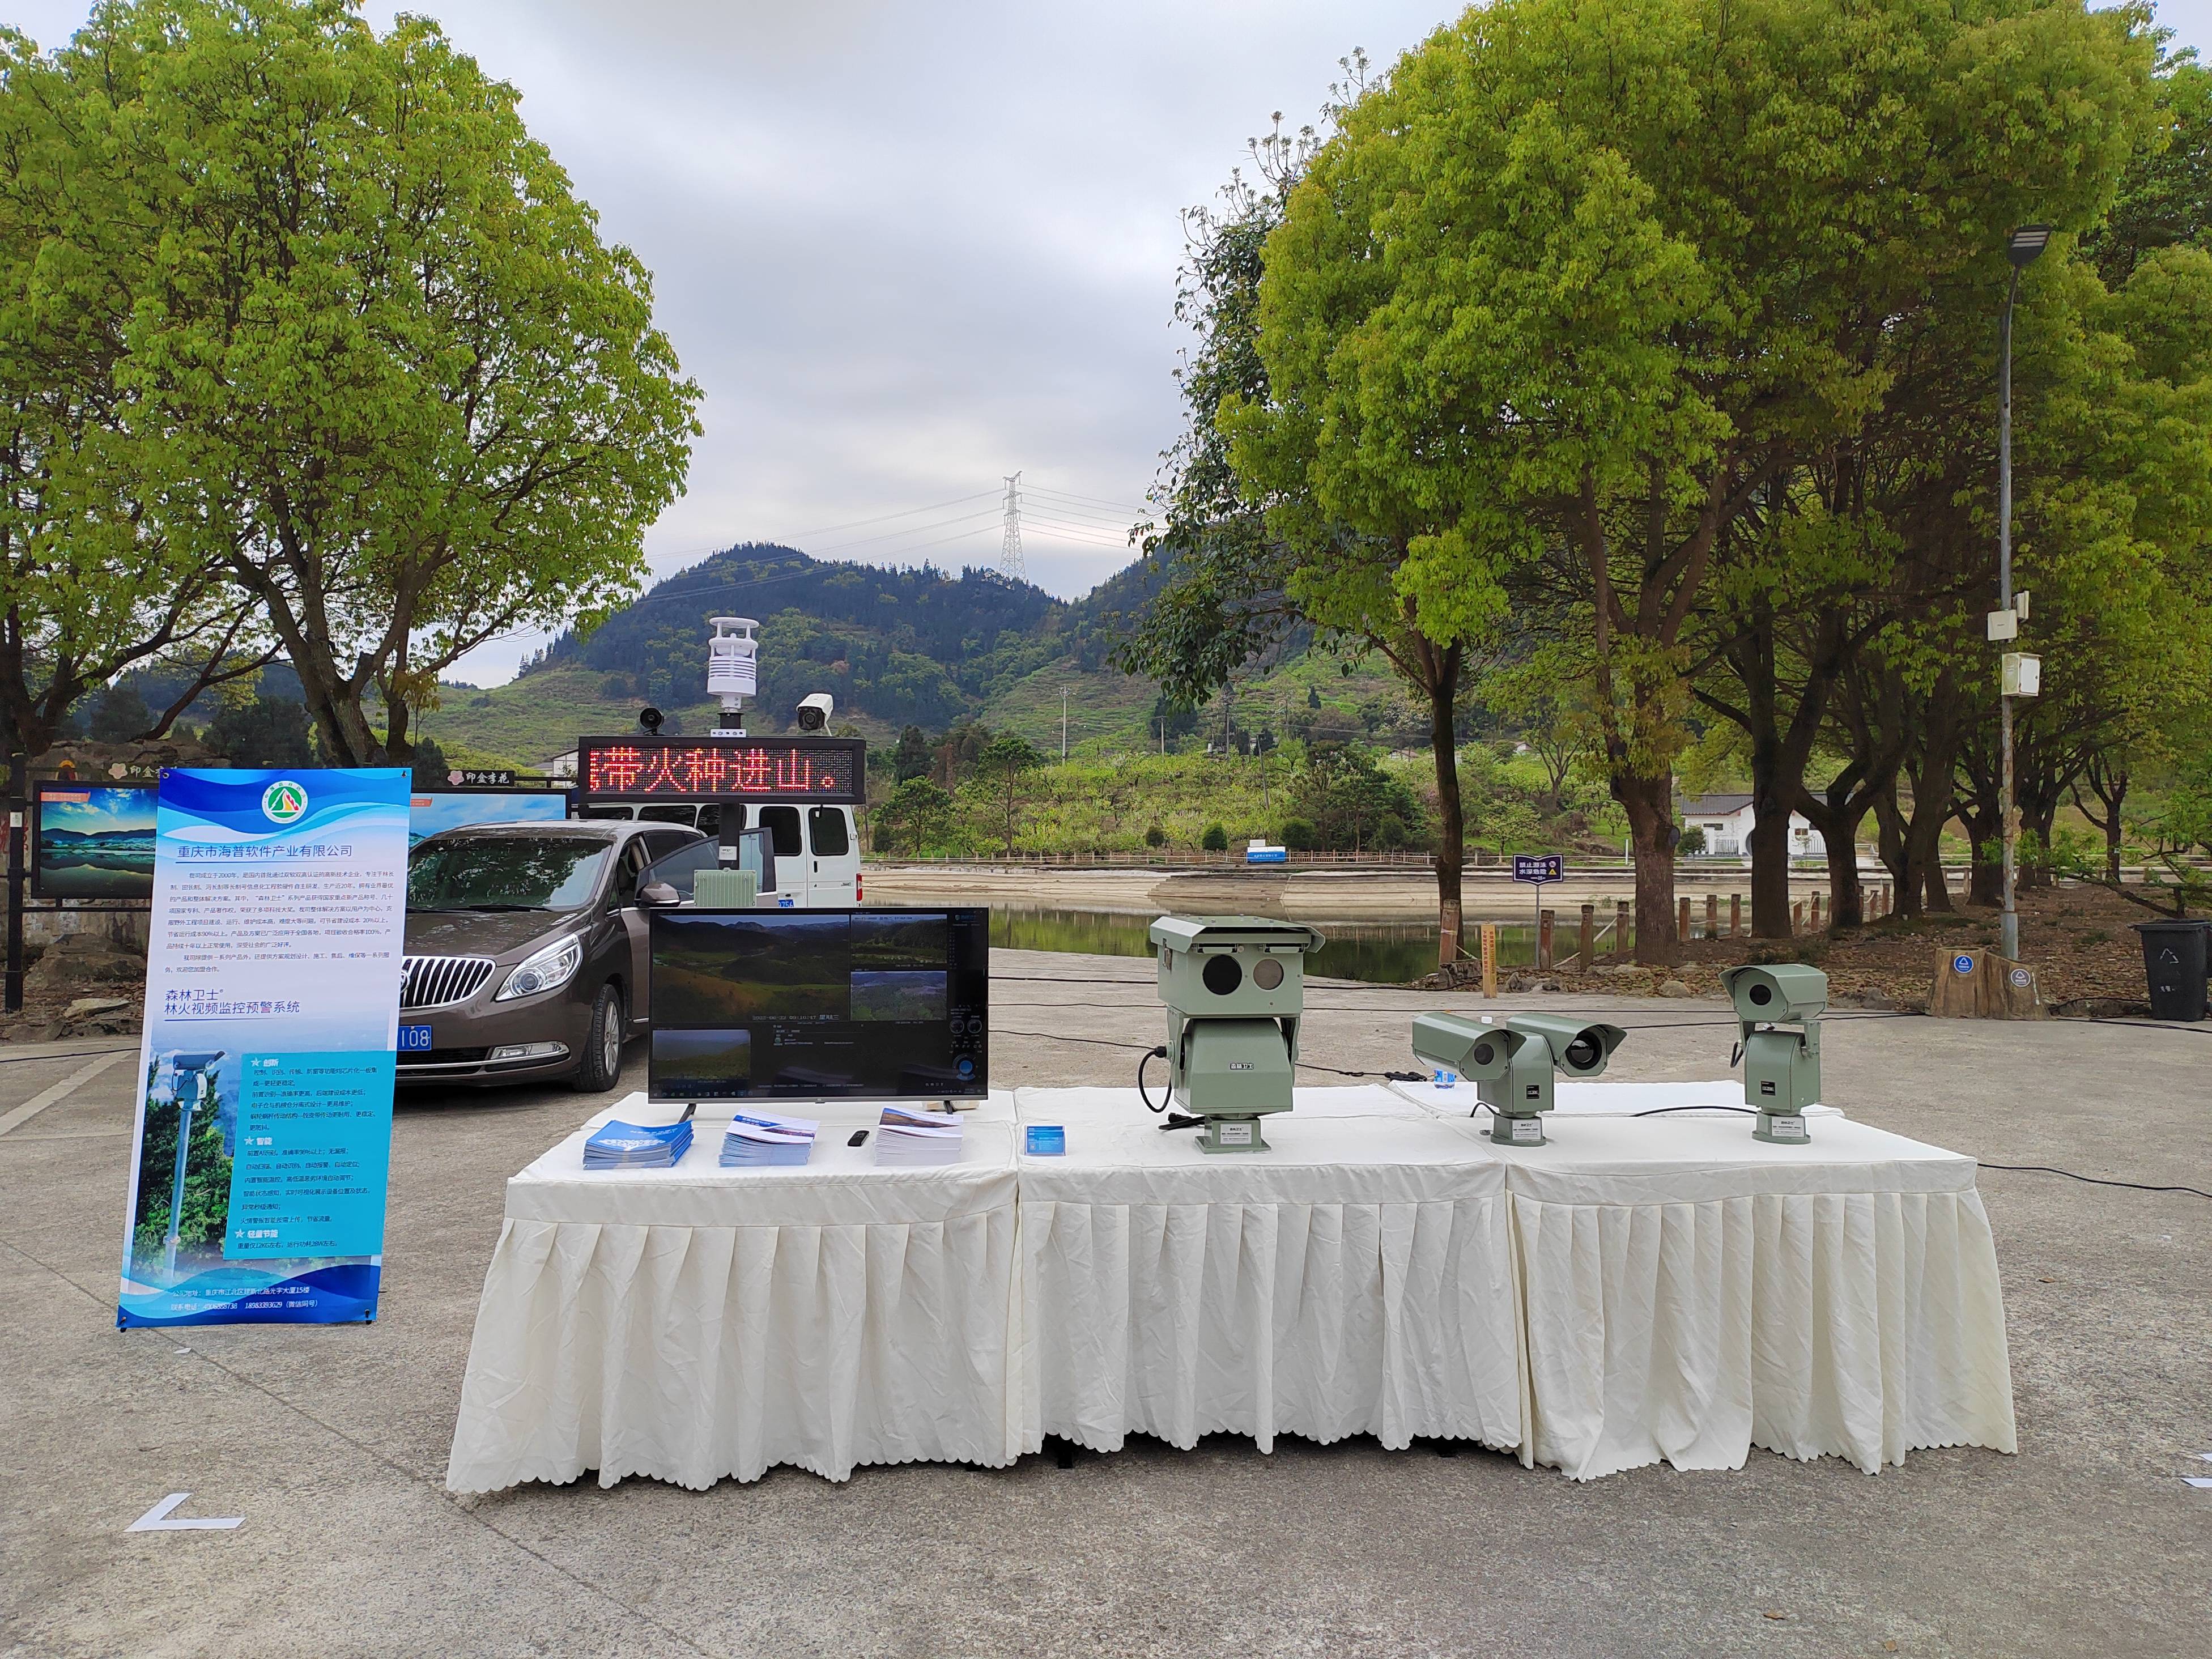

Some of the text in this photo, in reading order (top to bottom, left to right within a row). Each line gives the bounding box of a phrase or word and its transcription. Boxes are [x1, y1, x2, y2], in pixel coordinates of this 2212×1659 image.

[466, 772, 509, 784] 印盒李花
[177, 845, 352, 858] 重庆市海普软件产业有限公司
[164, 1001, 300, 1015] 林火视频监控预警系统
[402, 1030, 429, 1047] 108
[263, 1058, 279, 1067] 创新
[256, 1137, 273, 1146] 智能
[247, 1230, 278, 1239] 轻量节能
